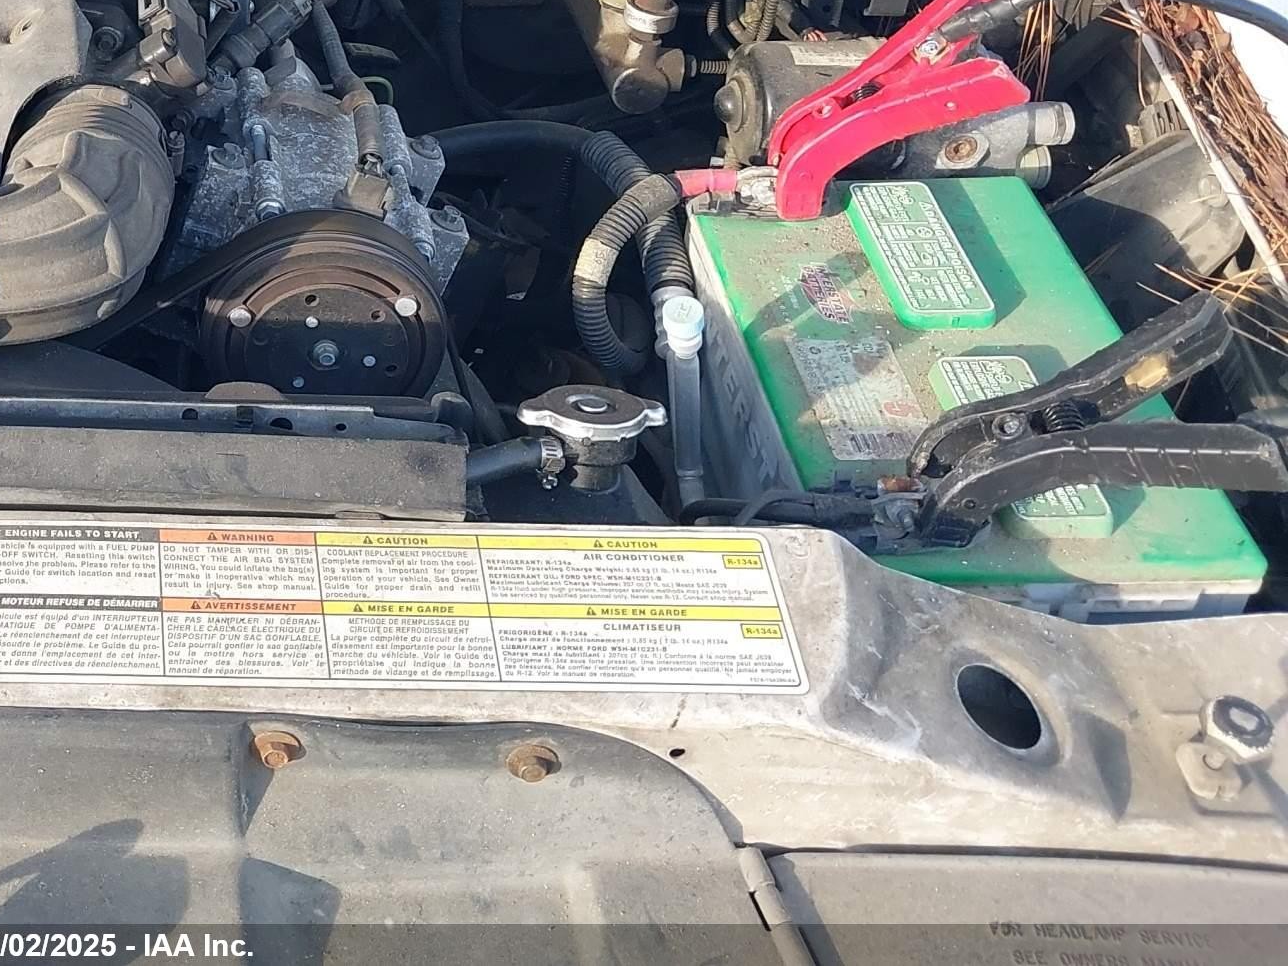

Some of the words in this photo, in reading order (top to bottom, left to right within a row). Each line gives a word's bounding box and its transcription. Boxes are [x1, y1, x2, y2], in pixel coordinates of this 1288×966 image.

[925, 205, 976, 290] DANGER/POISON
[801, 265, 834, 321] BATTERIES
[815, 265, 849, 323] INTERSTATE
[104, 531, 140, 539] START
[222, 534, 274, 542] WARNING
[377, 537, 428, 545] CAUTION
[607, 541, 657, 549] CAUTION
[39, 543, 75, 551] equipped
[65, 552, 105, 561] Resetting
[422, 550, 468, 558] PROCEDURE
[583, 553, 603, 561] AIR
[606, 554, 685, 562] CONDITIONER
[42, 561, 78, 569] problem.
[727, 558, 759, 566] R-134a
[288, 566, 314, 574] bag(s)
[216, 573, 263, 581] inoperative
[207, 582, 232, 590] injury.
[258, 583, 278, 591] shop
[2, 598, 43, 606] MOTEUR
[46, 598, 84, 606] REFUSE
[88, 599, 100, 607] DE
[103, 598, 158, 608] DÉMARRER
[205, 601, 296, 610] AVERTISSEMENT
[399, 605, 412, 613] EN
[602, 608, 629, 616] MISE
[632, 609, 647, 617] EN
[650, 609, 688, 617] GARDE
[603, 623, 681, 632] CLIMATISEUR
[745, 627, 778, 635] R-134a
